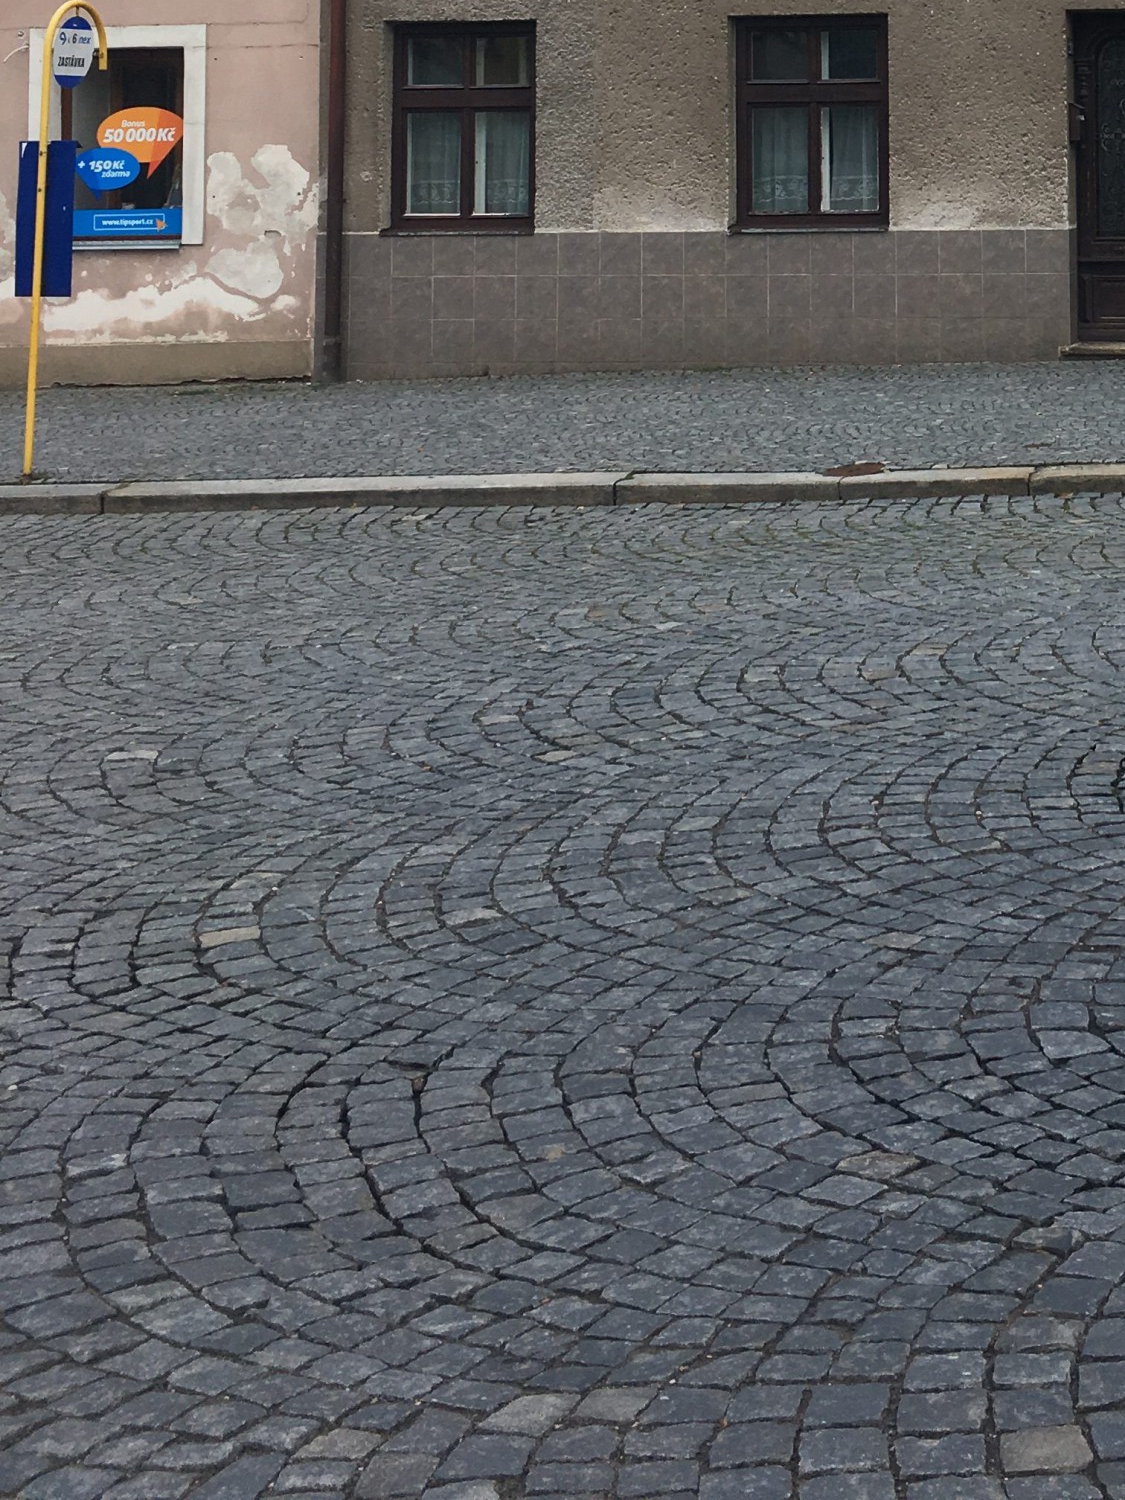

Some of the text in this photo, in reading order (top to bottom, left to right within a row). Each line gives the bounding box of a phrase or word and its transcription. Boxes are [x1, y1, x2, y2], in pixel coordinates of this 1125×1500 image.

[57, 55, 85, 67] ZASTÁVKA
[121, 119, 146, 128] Bonus
[101, 169, 131, 178] zdarma
